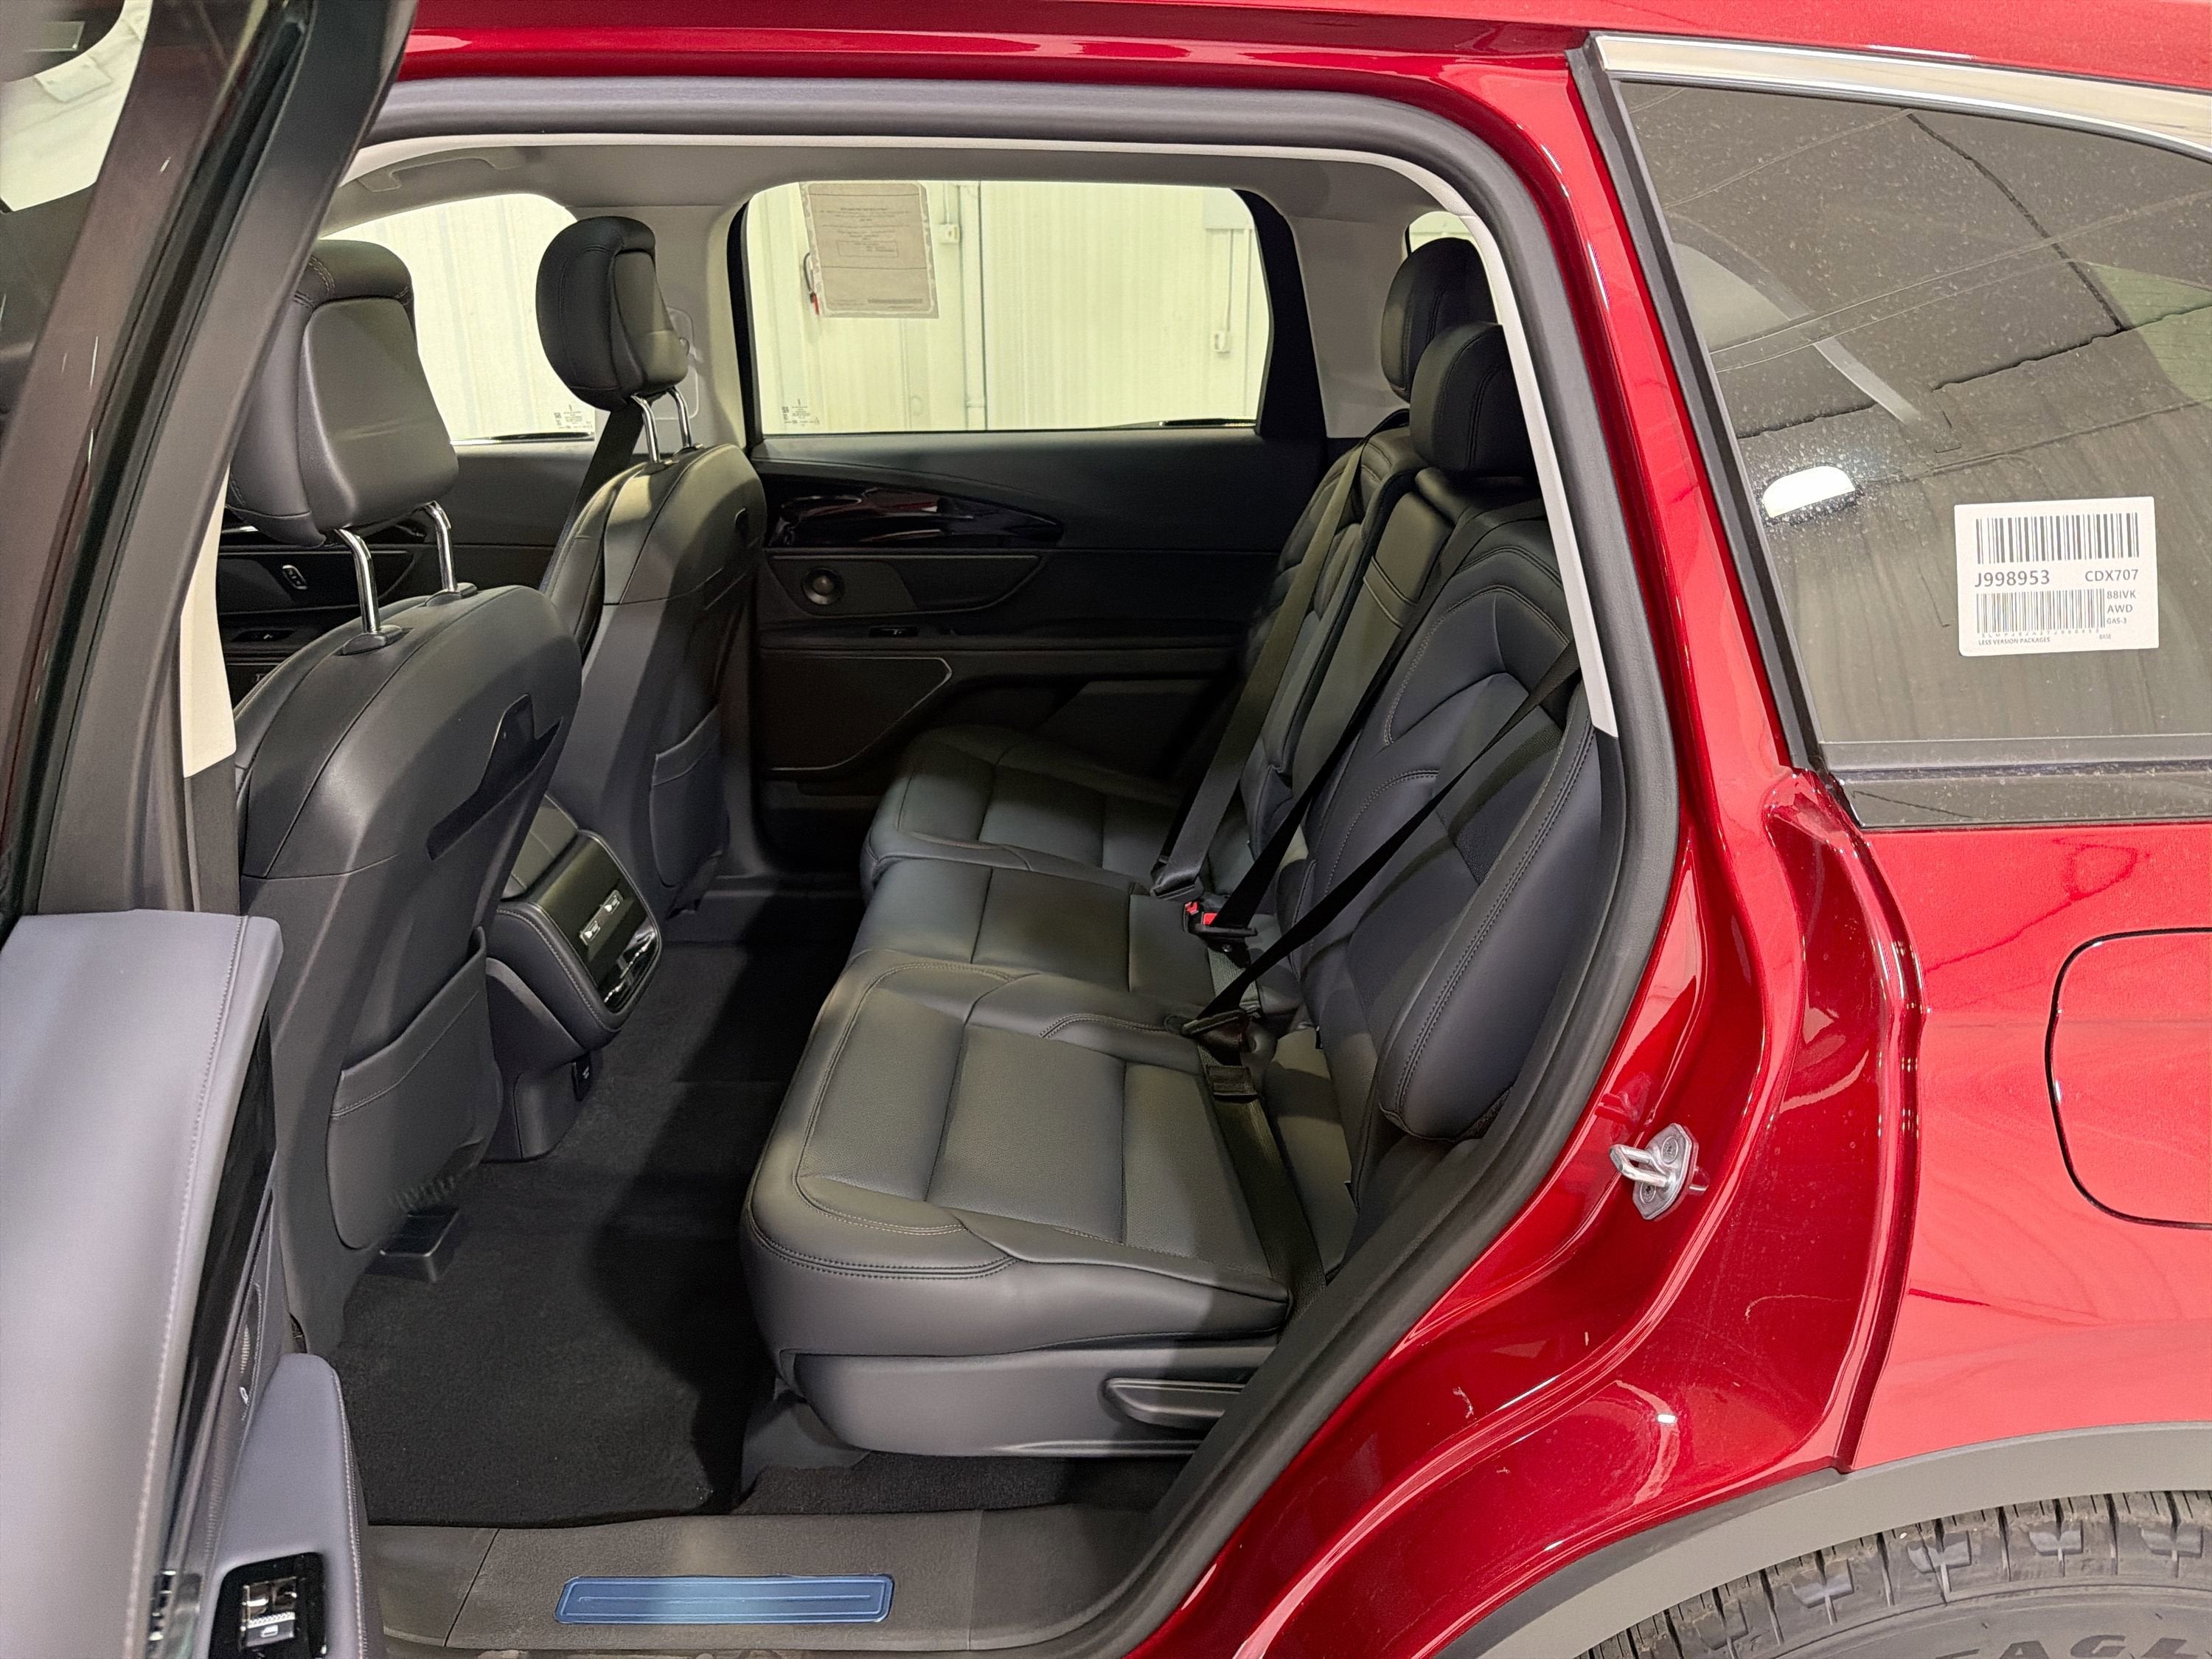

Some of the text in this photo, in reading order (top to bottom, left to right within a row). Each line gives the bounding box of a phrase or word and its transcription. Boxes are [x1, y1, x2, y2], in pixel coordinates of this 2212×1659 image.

[1974, 569, 2050, 588] J998953
[2084, 568, 2139, 582] CDX707
[2107, 604, 2133, 613] AWD
